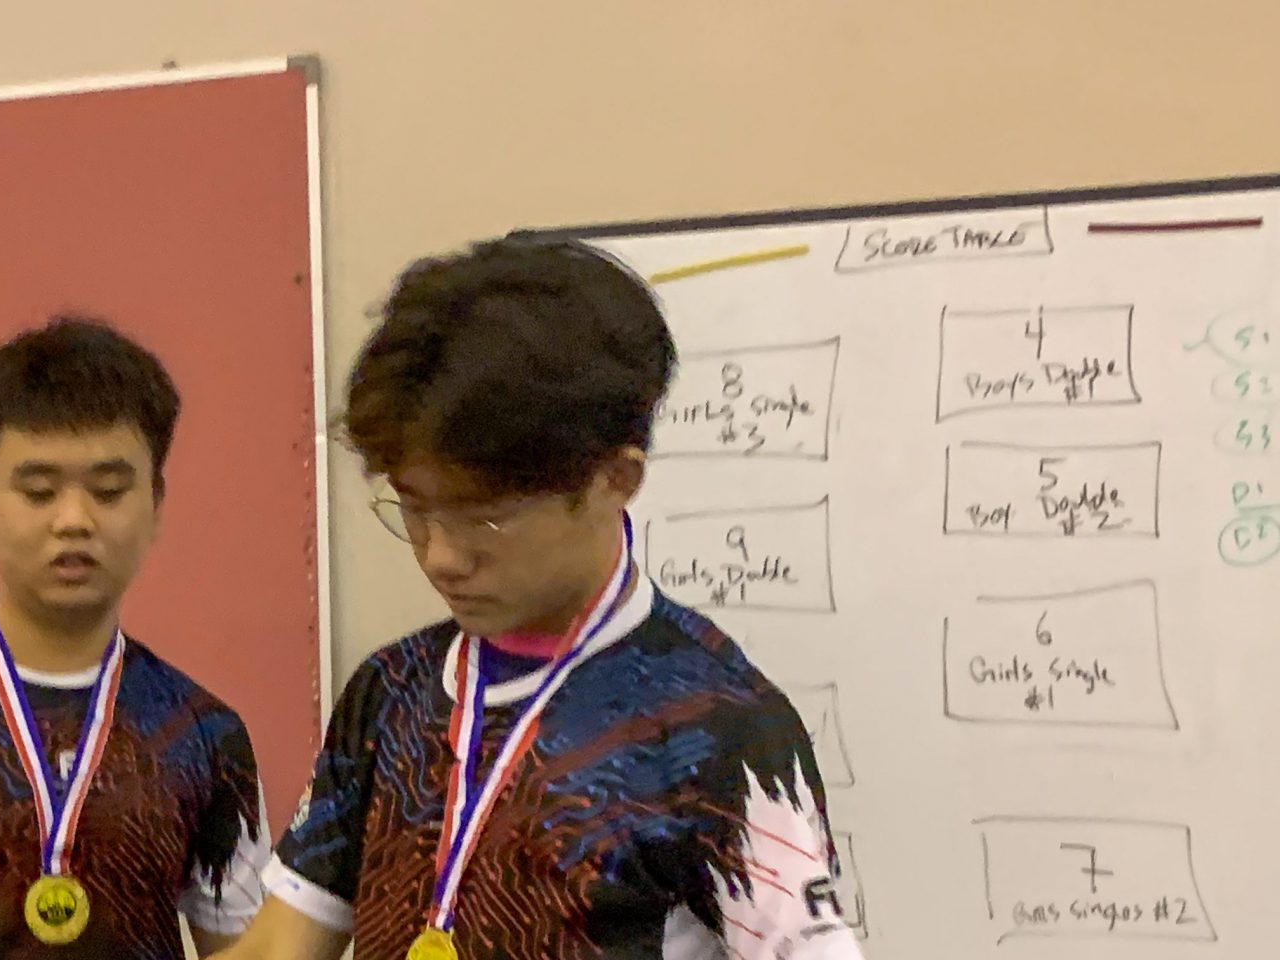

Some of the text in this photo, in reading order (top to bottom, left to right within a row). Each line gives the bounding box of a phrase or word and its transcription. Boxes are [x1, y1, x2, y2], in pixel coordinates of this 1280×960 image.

[1024, 304, 1045, 361] 4
[721, 361, 744, 399] 8
[1038, 457, 1068, 493] 5
[726, 525, 749, 562] 9
[1035, 610, 1053, 647] 6
[1059, 841, 1114, 894] 7
